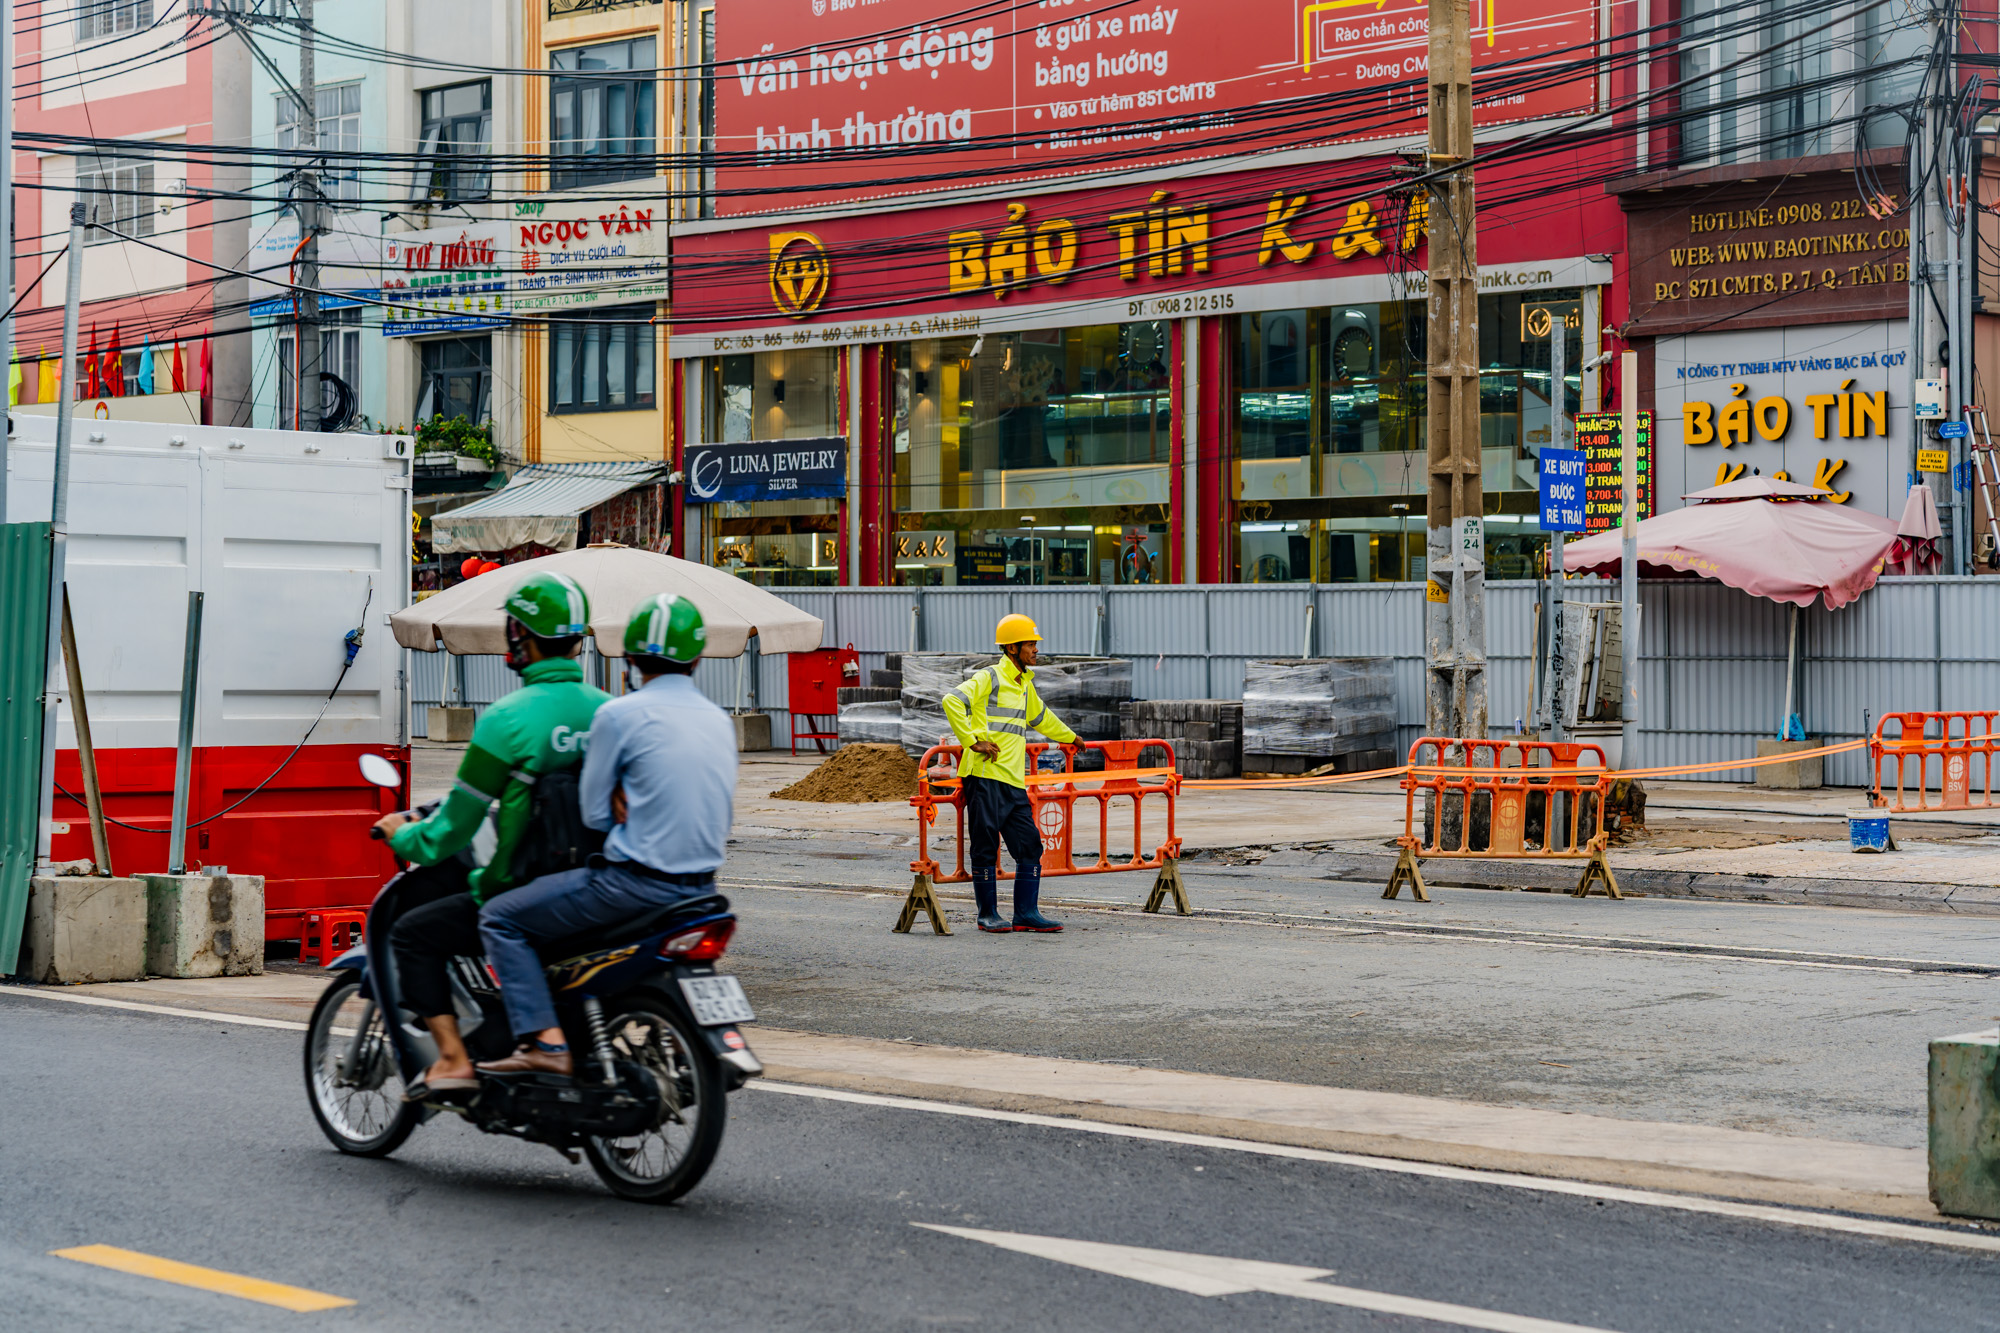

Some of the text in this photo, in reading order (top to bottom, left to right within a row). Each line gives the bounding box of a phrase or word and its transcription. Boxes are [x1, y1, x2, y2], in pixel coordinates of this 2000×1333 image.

[1056, 15, 1091, 51] gửi
[1097, 17, 1123, 39] xe
[1129, 6, 1178, 35] máy
[1335, 25, 1360, 43] Rào
[1363, 18, 1396, 39] chắn
[810, 37, 889, 91] hoạt
[898, 24, 995, 80] động
[1096, 49, 1168, 77] hướng
[1356, 62, 1400, 80] Đường
[1137, 88, 1163, 108] 851
[1166, 81, 1216, 104] CMT8
[520, 204, 653, 250] NGỌC VÂN
[1690, 207, 1775, 234] HOTLINE:
[948, 202, 1081, 302] BẢO
[1107, 188, 1211, 281] TÍN
[1256, 190, 1315, 268] K
[1331, 200, 1386, 261] &
[550, 251, 570, 267] DỊCH
[573, 249, 585, 265] VỤ
[1655, 281, 1682, 302] ĐC
[1689, 278, 1719, 298] 871
[1850, 261, 1888, 286] TÂN
[1128, 293, 1234, 317] ĐT: 0908 212 515
[713, 337, 733, 351] ĐC:
[763, 332, 782, 347] 865
[822, 327, 841, 342] 869
[1687, 363, 1719, 378] CÔNG
[1720, 363, 1737, 376] TY
[1738, 361, 1770, 376] TNHH
[1771, 359, 1797, 374] MTV
[1799, 355, 1832, 372] VÀNG
[1833, 355, 1859, 372] BẠC
[1860, 352, 1878, 368] ĐÁ
[1880, 350, 1907, 367] QUÝ
[1682, 378, 1891, 450] BẢO TÍN
[1580, 434, 1610, 446] 13.400
[729, 450, 839, 475] LUNA JEWELRY
[1544, 455, 1584, 477] XE BUÝT
[768, 478, 798, 491] SILVER
[1811, 457, 1854, 504] K
[1549, 481, 1576, 505] ĐƯỢC
[1546, 504, 1583, 525] RẼ TRÁI
[1597, 502, 1622, 514] TRAN
[1463, 527, 1480, 535] 873
[1466, 519, 1478, 527] CM
[931, 535, 949, 558] K
[1463, 538, 1479, 549] 24
[1430, 587, 1440, 597] 24
[1948, 781, 1963, 792] BSV
[1498, 827, 1518, 841] BSV
